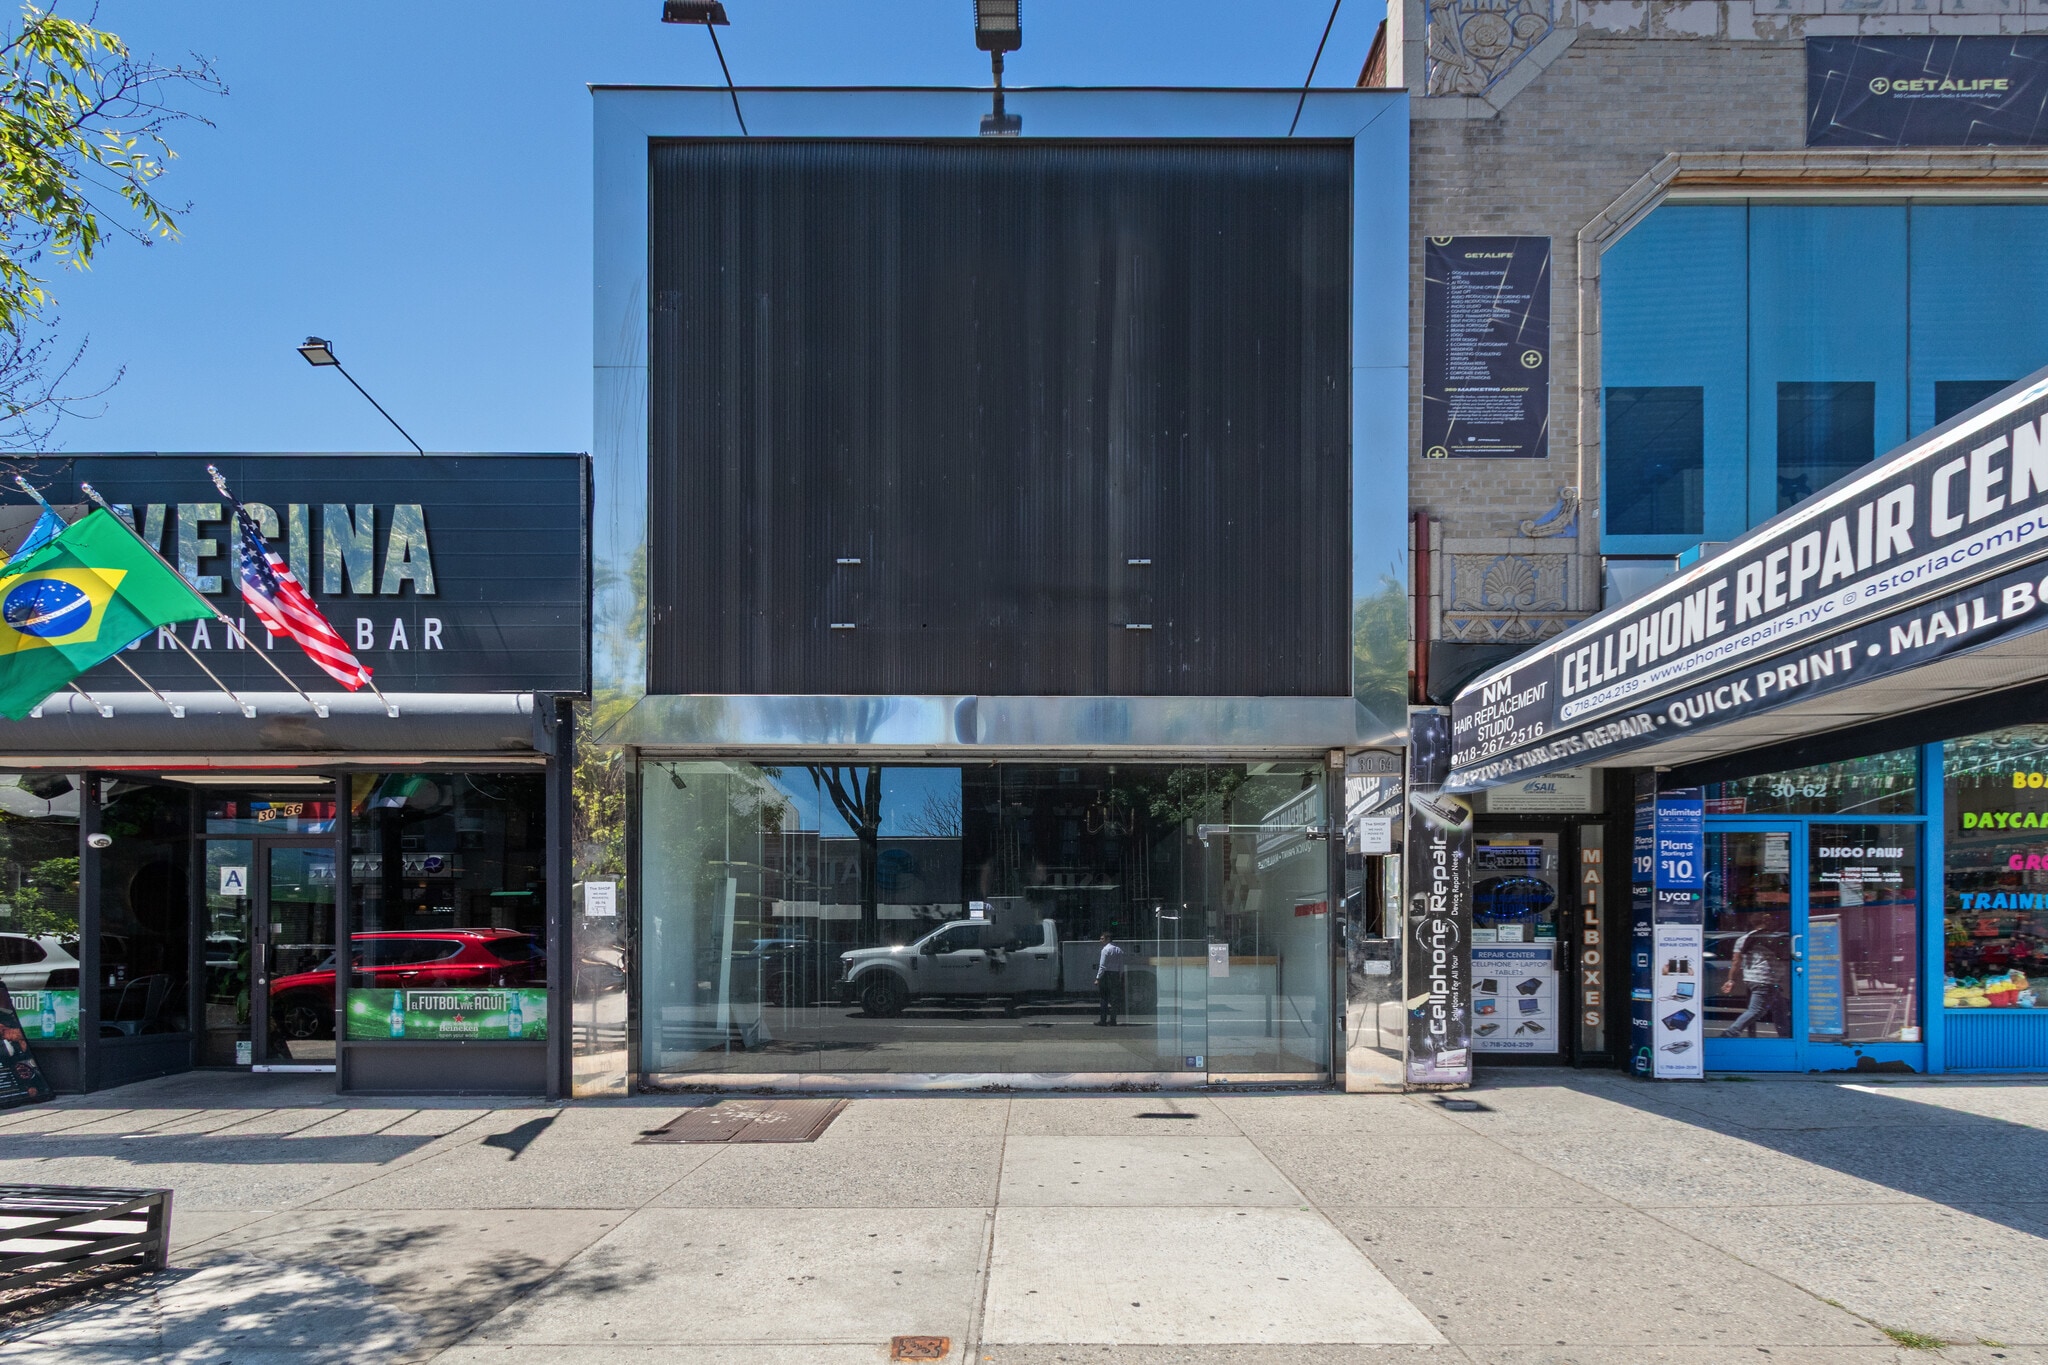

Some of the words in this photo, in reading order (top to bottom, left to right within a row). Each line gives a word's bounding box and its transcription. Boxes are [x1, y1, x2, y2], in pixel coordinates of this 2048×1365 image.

[1892, 78, 2009, 91] GETALIFE
[1562, 577, 1728, 698] CELLPHONE
[1735, 484, 1915, 626] REPAIR
[357, 618, 443, 651] BAR
[1574, 679, 1639, 713] 718.204.2139
[1650, 600, 1835, 682] www.phonerepairs.nyc
[1668, 677, 1753, 728] QUICK
[1757, 641, 1858, 698] PRINT
[1890, 576, 2048, 656] MAILB
[1482, 676, 1512, 706] NM
[1454, 715, 1472, 736] HAIR
[1474, 681, 1548, 726] REPLACEMENT
[1477, 715, 1514, 743] STUDIO
[1457, 721, 1544, 765] 718-267-2516
[1358, 758, 1373, 772] 30
[1380, 757, 1393, 772] 64
[1534, 783, 1556, 791] SAIL
[2012, 771, 2048, 789] BO
[1771, 784, 1827, 798] 30-62
[260, 809, 275, 821] 30
[285, 804, 302, 816] 66
[1659, 808, 1701, 817] Unlimited
[1635, 836, 1653, 844] Plans
[1660, 840, 1694, 850] Plans
[1452, 850, 1460, 871] Needs
[1660, 850, 1686, 858] Starting
[1819, 847, 1864, 858] DISCO
[1867, 847, 1904, 858] PAWS
[1497, 857, 1540, 866] REPAIR
[1634, 856, 1652, 873] $19
[1661, 860, 1693, 879] $10
[225, 870, 242, 887] A
[1429, 836, 1450, 912] Repair
[1452, 872, 1460, 893] Repair
[1452, 894, 1460, 916] Device
[1658, 891, 1691, 902] Lyca
[1959, 893, 2048, 910] TRAINI
[1582, 849, 1601, 1026] MAILBOXES
[1429, 918, 1450, 1035] Cellphone
[1452, 980, 1460, 990] For
[412, 1002, 419, 1010] EL
[419, 996, 460, 1010] FUTBOL
[460, 1002, 474, 1010] VIVE
[1452, 991, 1460, 1022] Solutions
[440, 1024, 478, 1032] Heineken
[1632, 1018, 1648, 1026] Lyca
